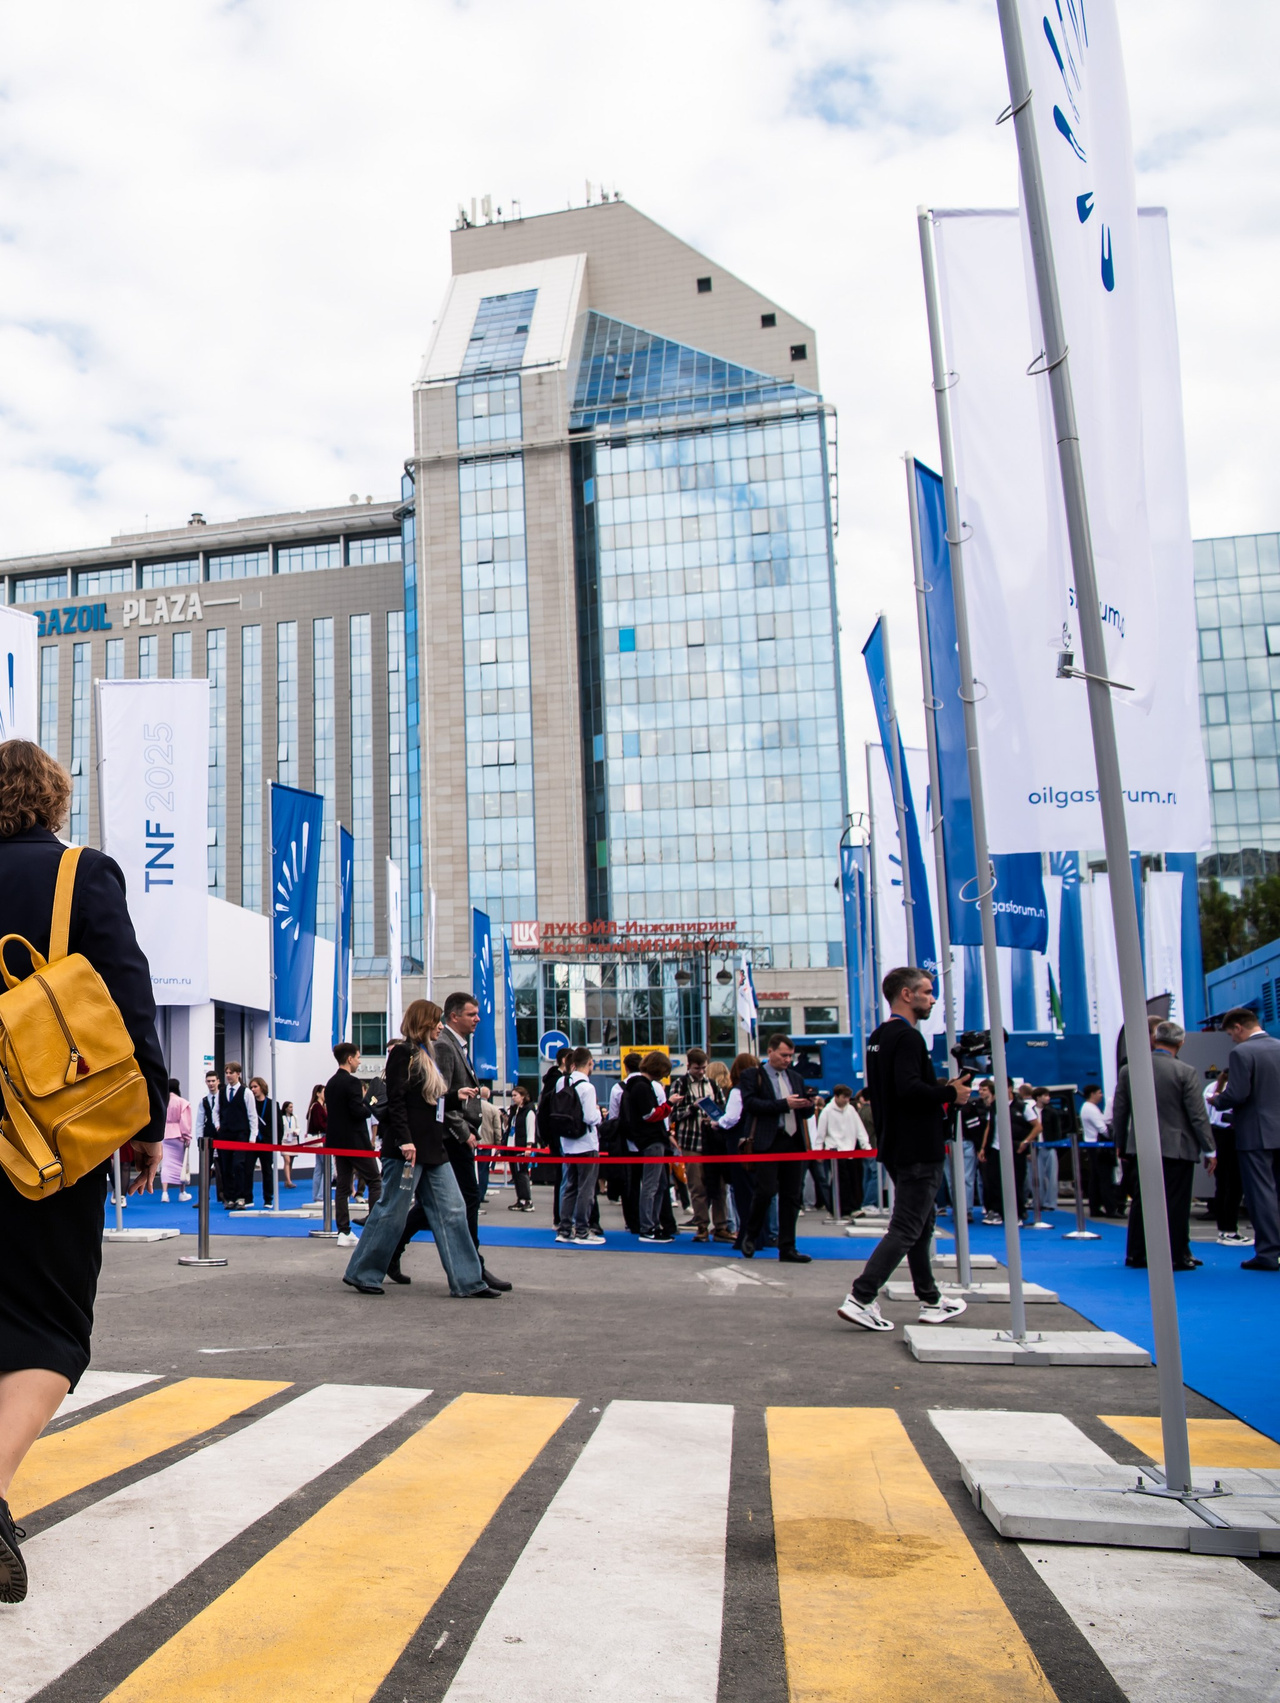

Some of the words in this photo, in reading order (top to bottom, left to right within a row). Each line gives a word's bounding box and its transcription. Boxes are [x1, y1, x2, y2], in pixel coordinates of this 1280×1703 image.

[123, 592, 203, 628] PLAZA
[143, 722, 175, 812] 2025
[144, 819, 175, 893] TNF
[543, 918, 737, 936] ЛУКОЙЛ-Инжиниринг
